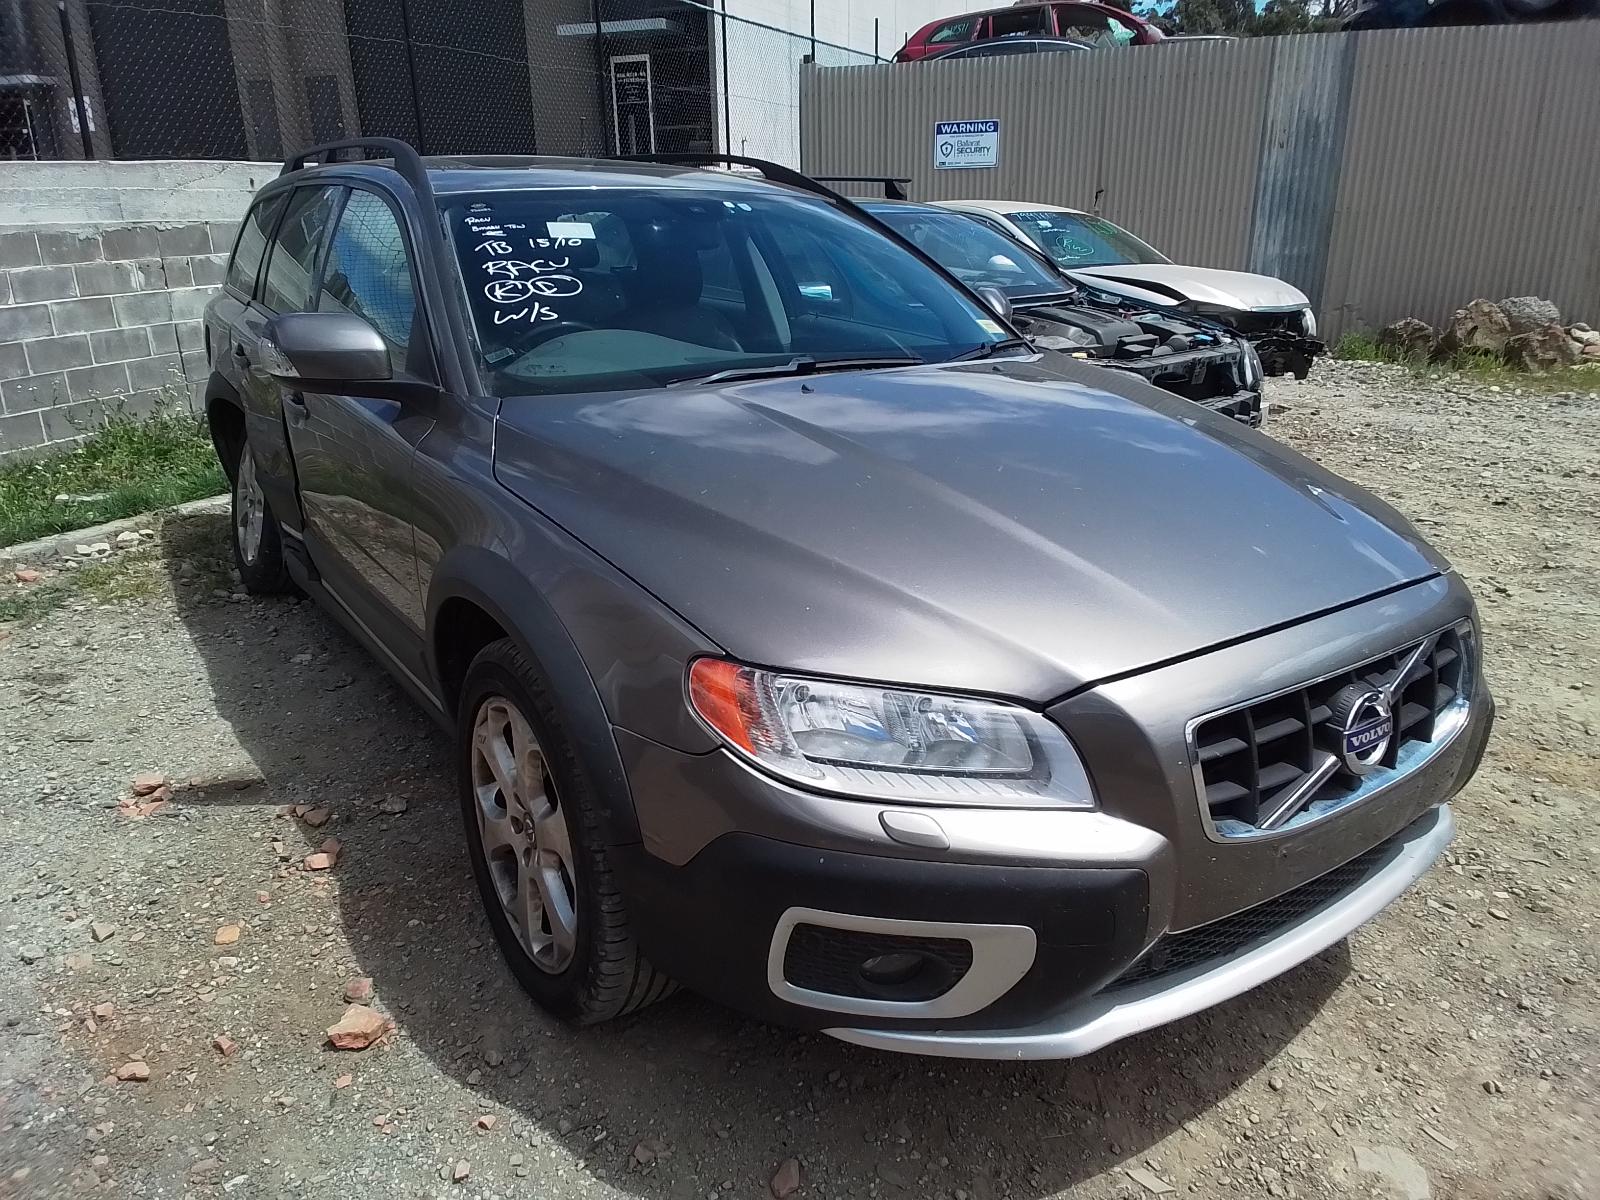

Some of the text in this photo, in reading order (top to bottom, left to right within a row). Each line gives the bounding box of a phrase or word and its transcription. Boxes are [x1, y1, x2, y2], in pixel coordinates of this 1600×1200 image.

[941, 122, 995, 133] WARNING
[956, 146, 991, 154] SECURITY
[474, 237, 582, 256] TB 15/10
[493, 302, 558, 325] W/S
[1350, 722, 1391, 747] VOLVO
